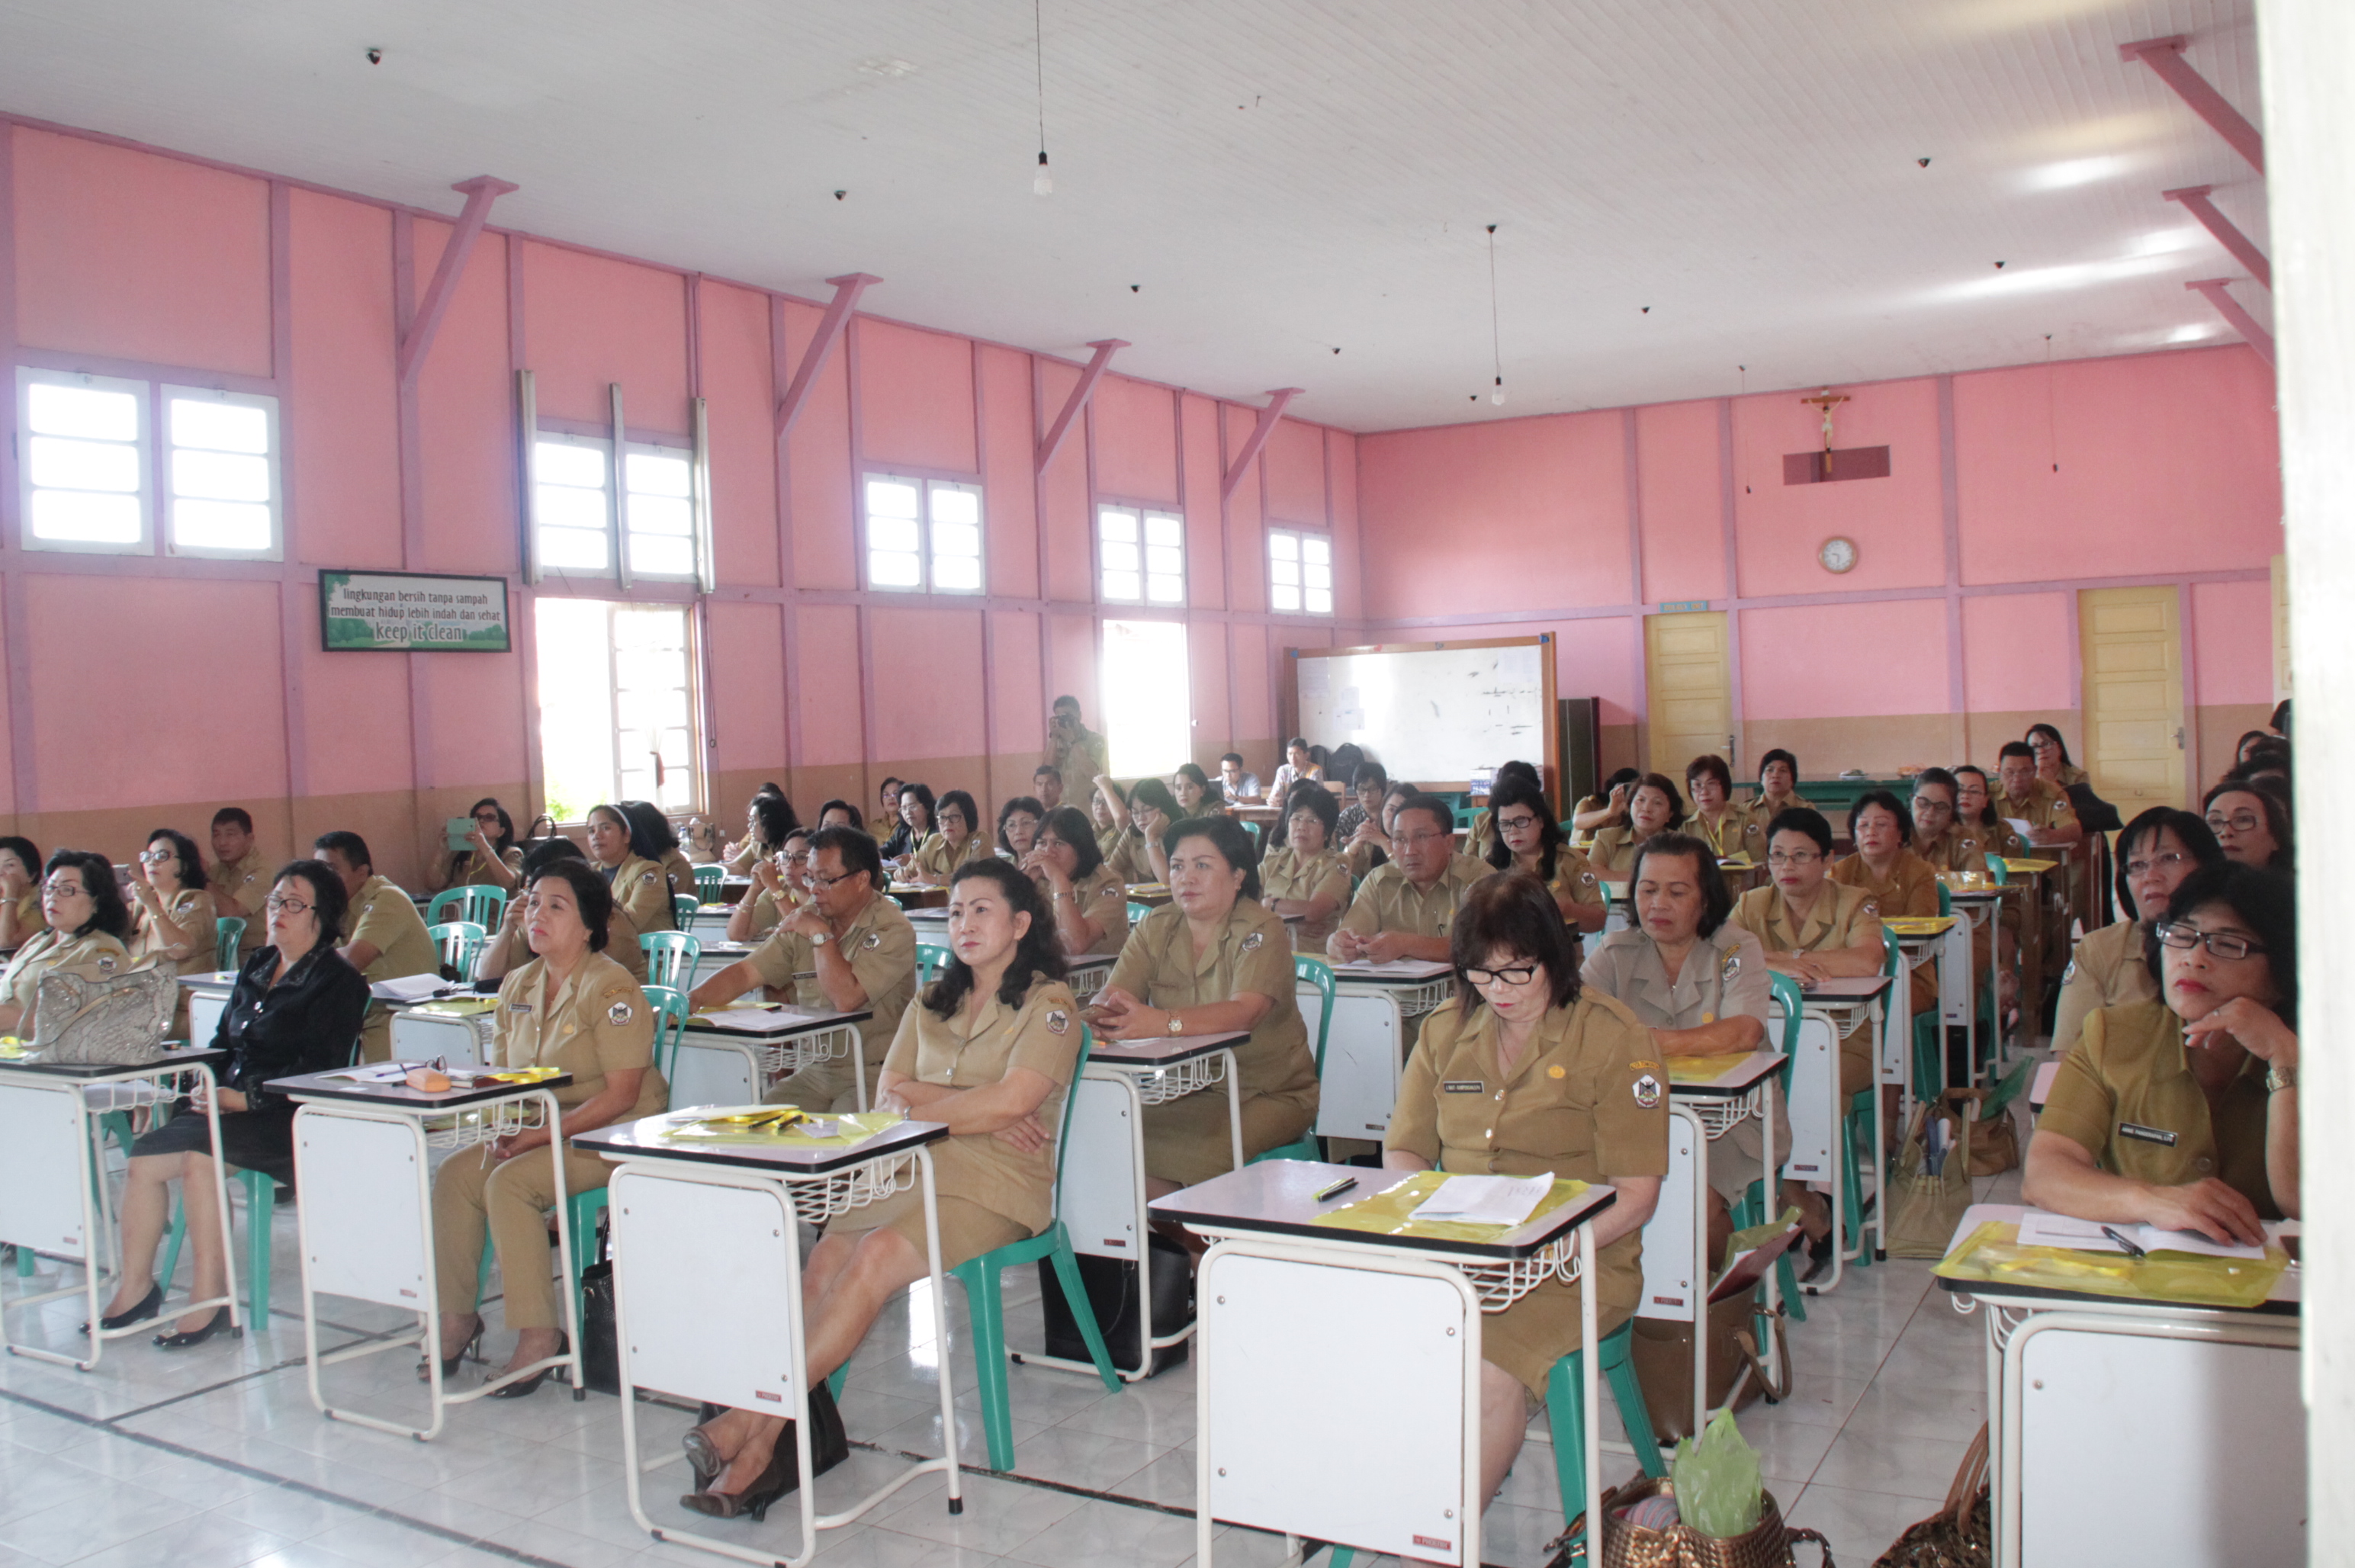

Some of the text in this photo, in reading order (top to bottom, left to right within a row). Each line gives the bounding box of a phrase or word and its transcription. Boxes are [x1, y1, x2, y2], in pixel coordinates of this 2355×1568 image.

[344, 588, 488, 606] lingkungan bersih tanpa sampah
[331, 606, 501, 621] membuat hidup lebih indah dan sehat
[376, 622, 461, 643] keep it clean
[1422, 1537, 1447, 1548] PHOENIX
